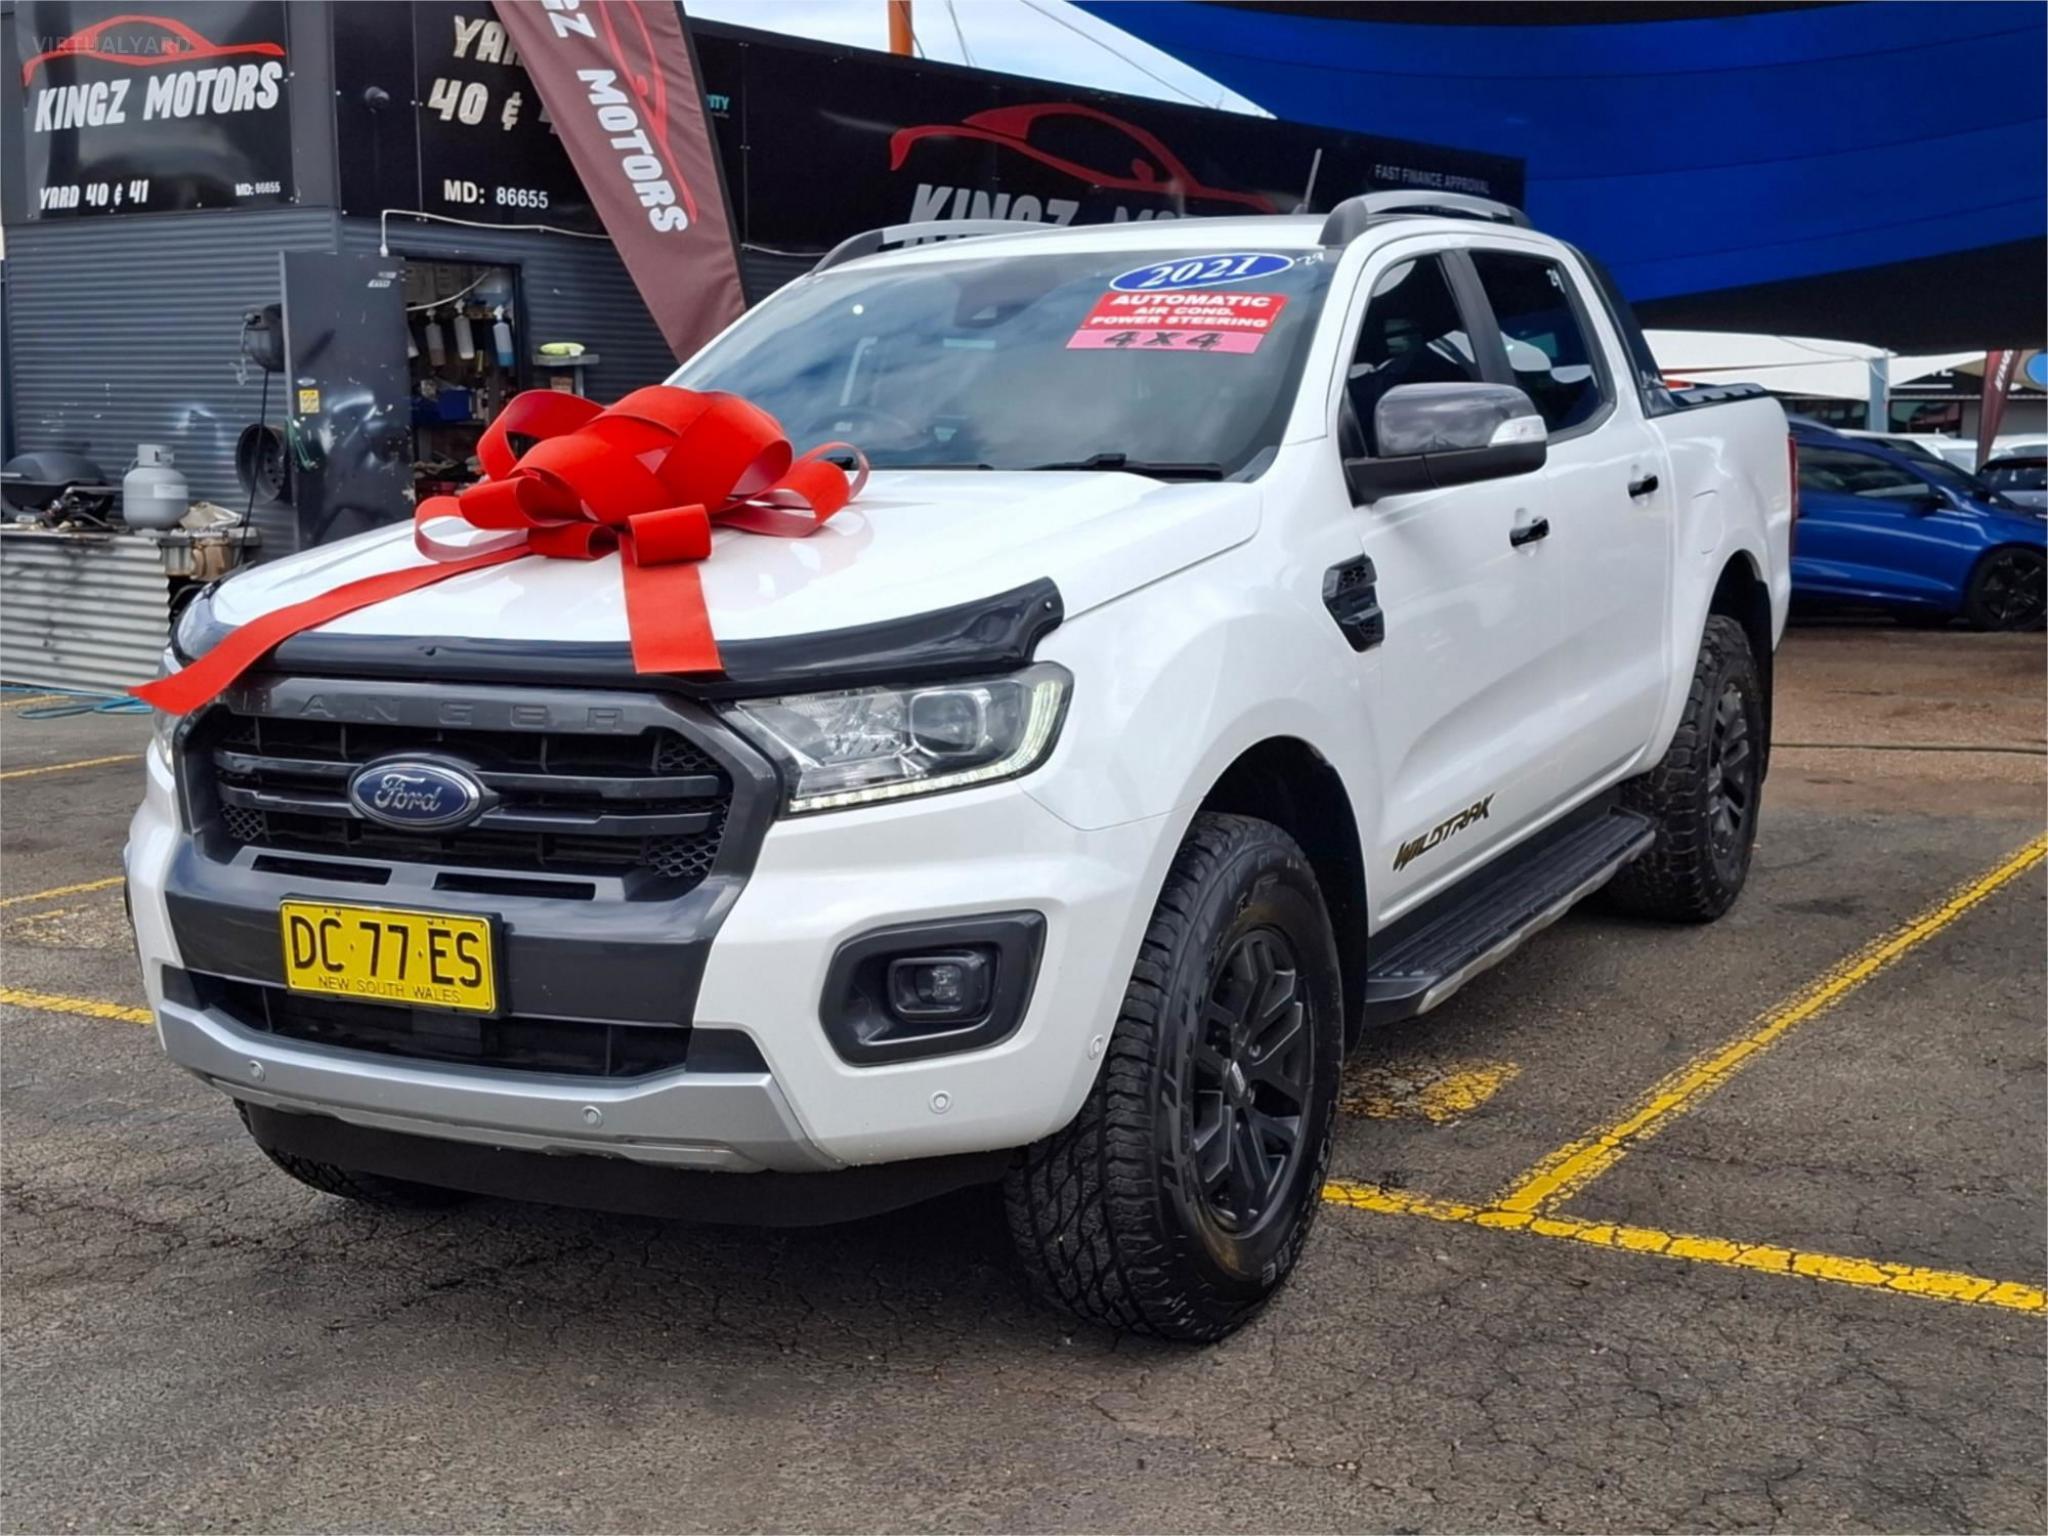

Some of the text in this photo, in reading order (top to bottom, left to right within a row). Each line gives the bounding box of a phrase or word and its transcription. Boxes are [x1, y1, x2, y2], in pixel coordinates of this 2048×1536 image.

[34, 61, 283, 132] KINGZ MOTORS
[427, 78, 489, 126] 40
[576, 70, 689, 232] MOTORS
[1375, 164, 1399, 180] FAST
[40, 184, 80, 210] YARD
[86, 182, 109, 206] 40
[128, 179, 149, 203] 41
[235, 183, 254, 197] MD:
[443, 179, 549, 209] MD: 86655
[1137, 255, 1260, 288] 2021
[1110, 294, 1271, 307] AUTOMATIC
[1134, 306, 1234, 317] AIR COND.
[1090, 315, 1268, 328] POWER STEERING
[373, 773, 442, 813] Ford
[290, 915, 483, 989] DC 77 ES
[318, 975, 461, 1004] NEW SOUTH WALES
